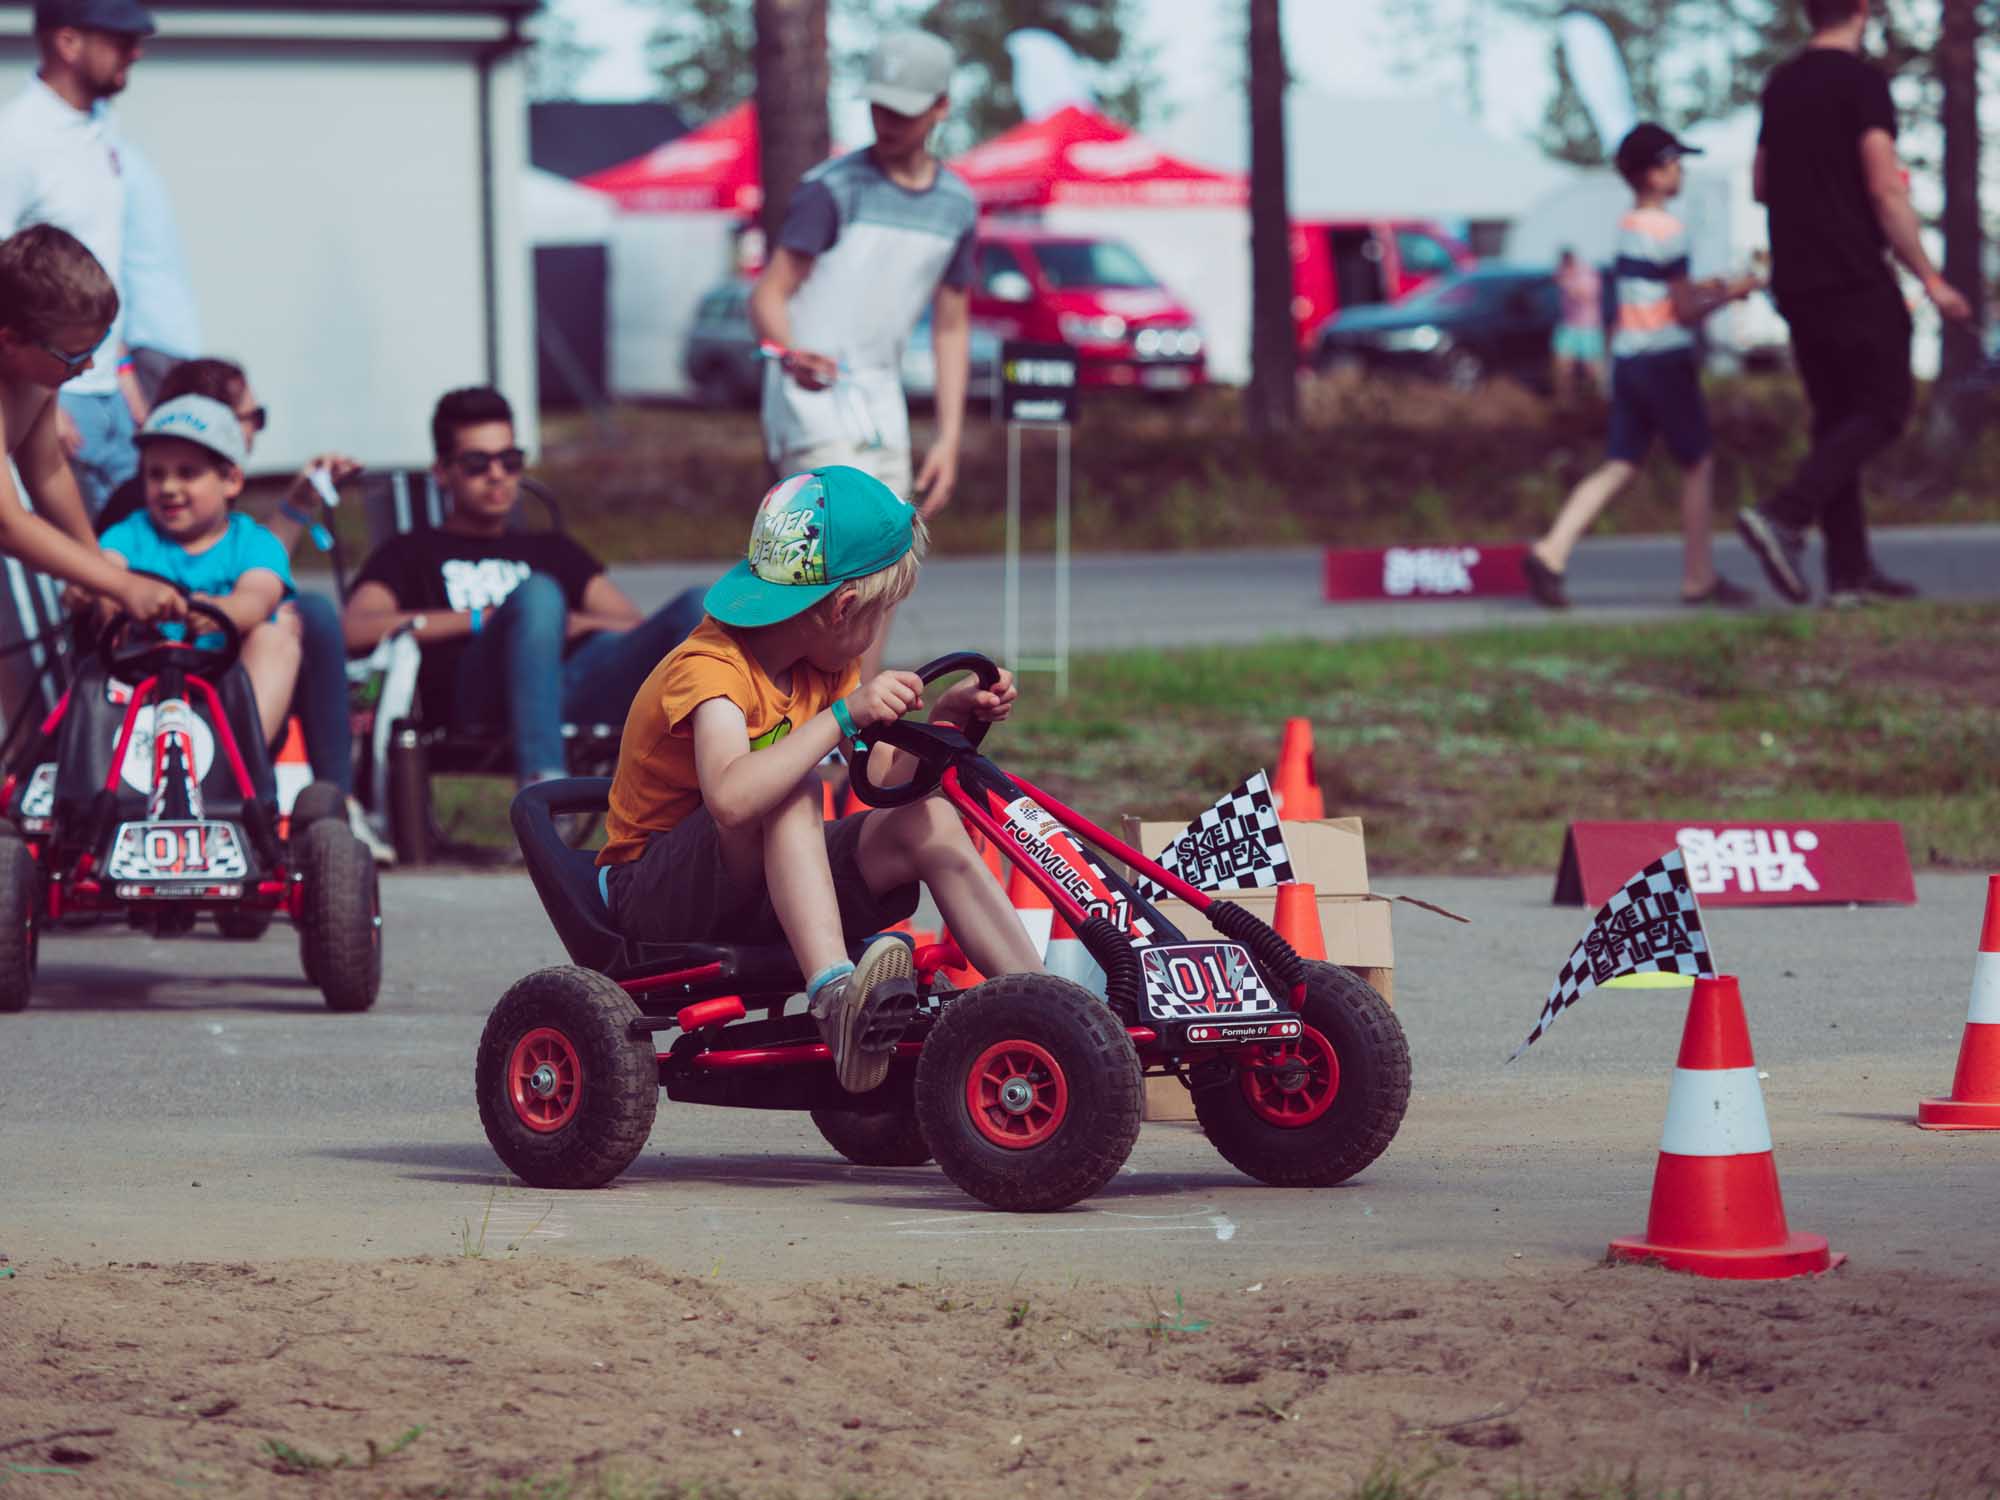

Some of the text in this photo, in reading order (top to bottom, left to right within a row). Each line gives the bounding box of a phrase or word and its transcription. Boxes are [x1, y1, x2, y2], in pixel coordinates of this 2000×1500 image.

[144, 828, 207, 870] 01
[1004, 818, 1091, 900] FORMULE
[1167, 955, 1233, 1001] 01
[1221, 1027, 1268, 1037] Formule 01
